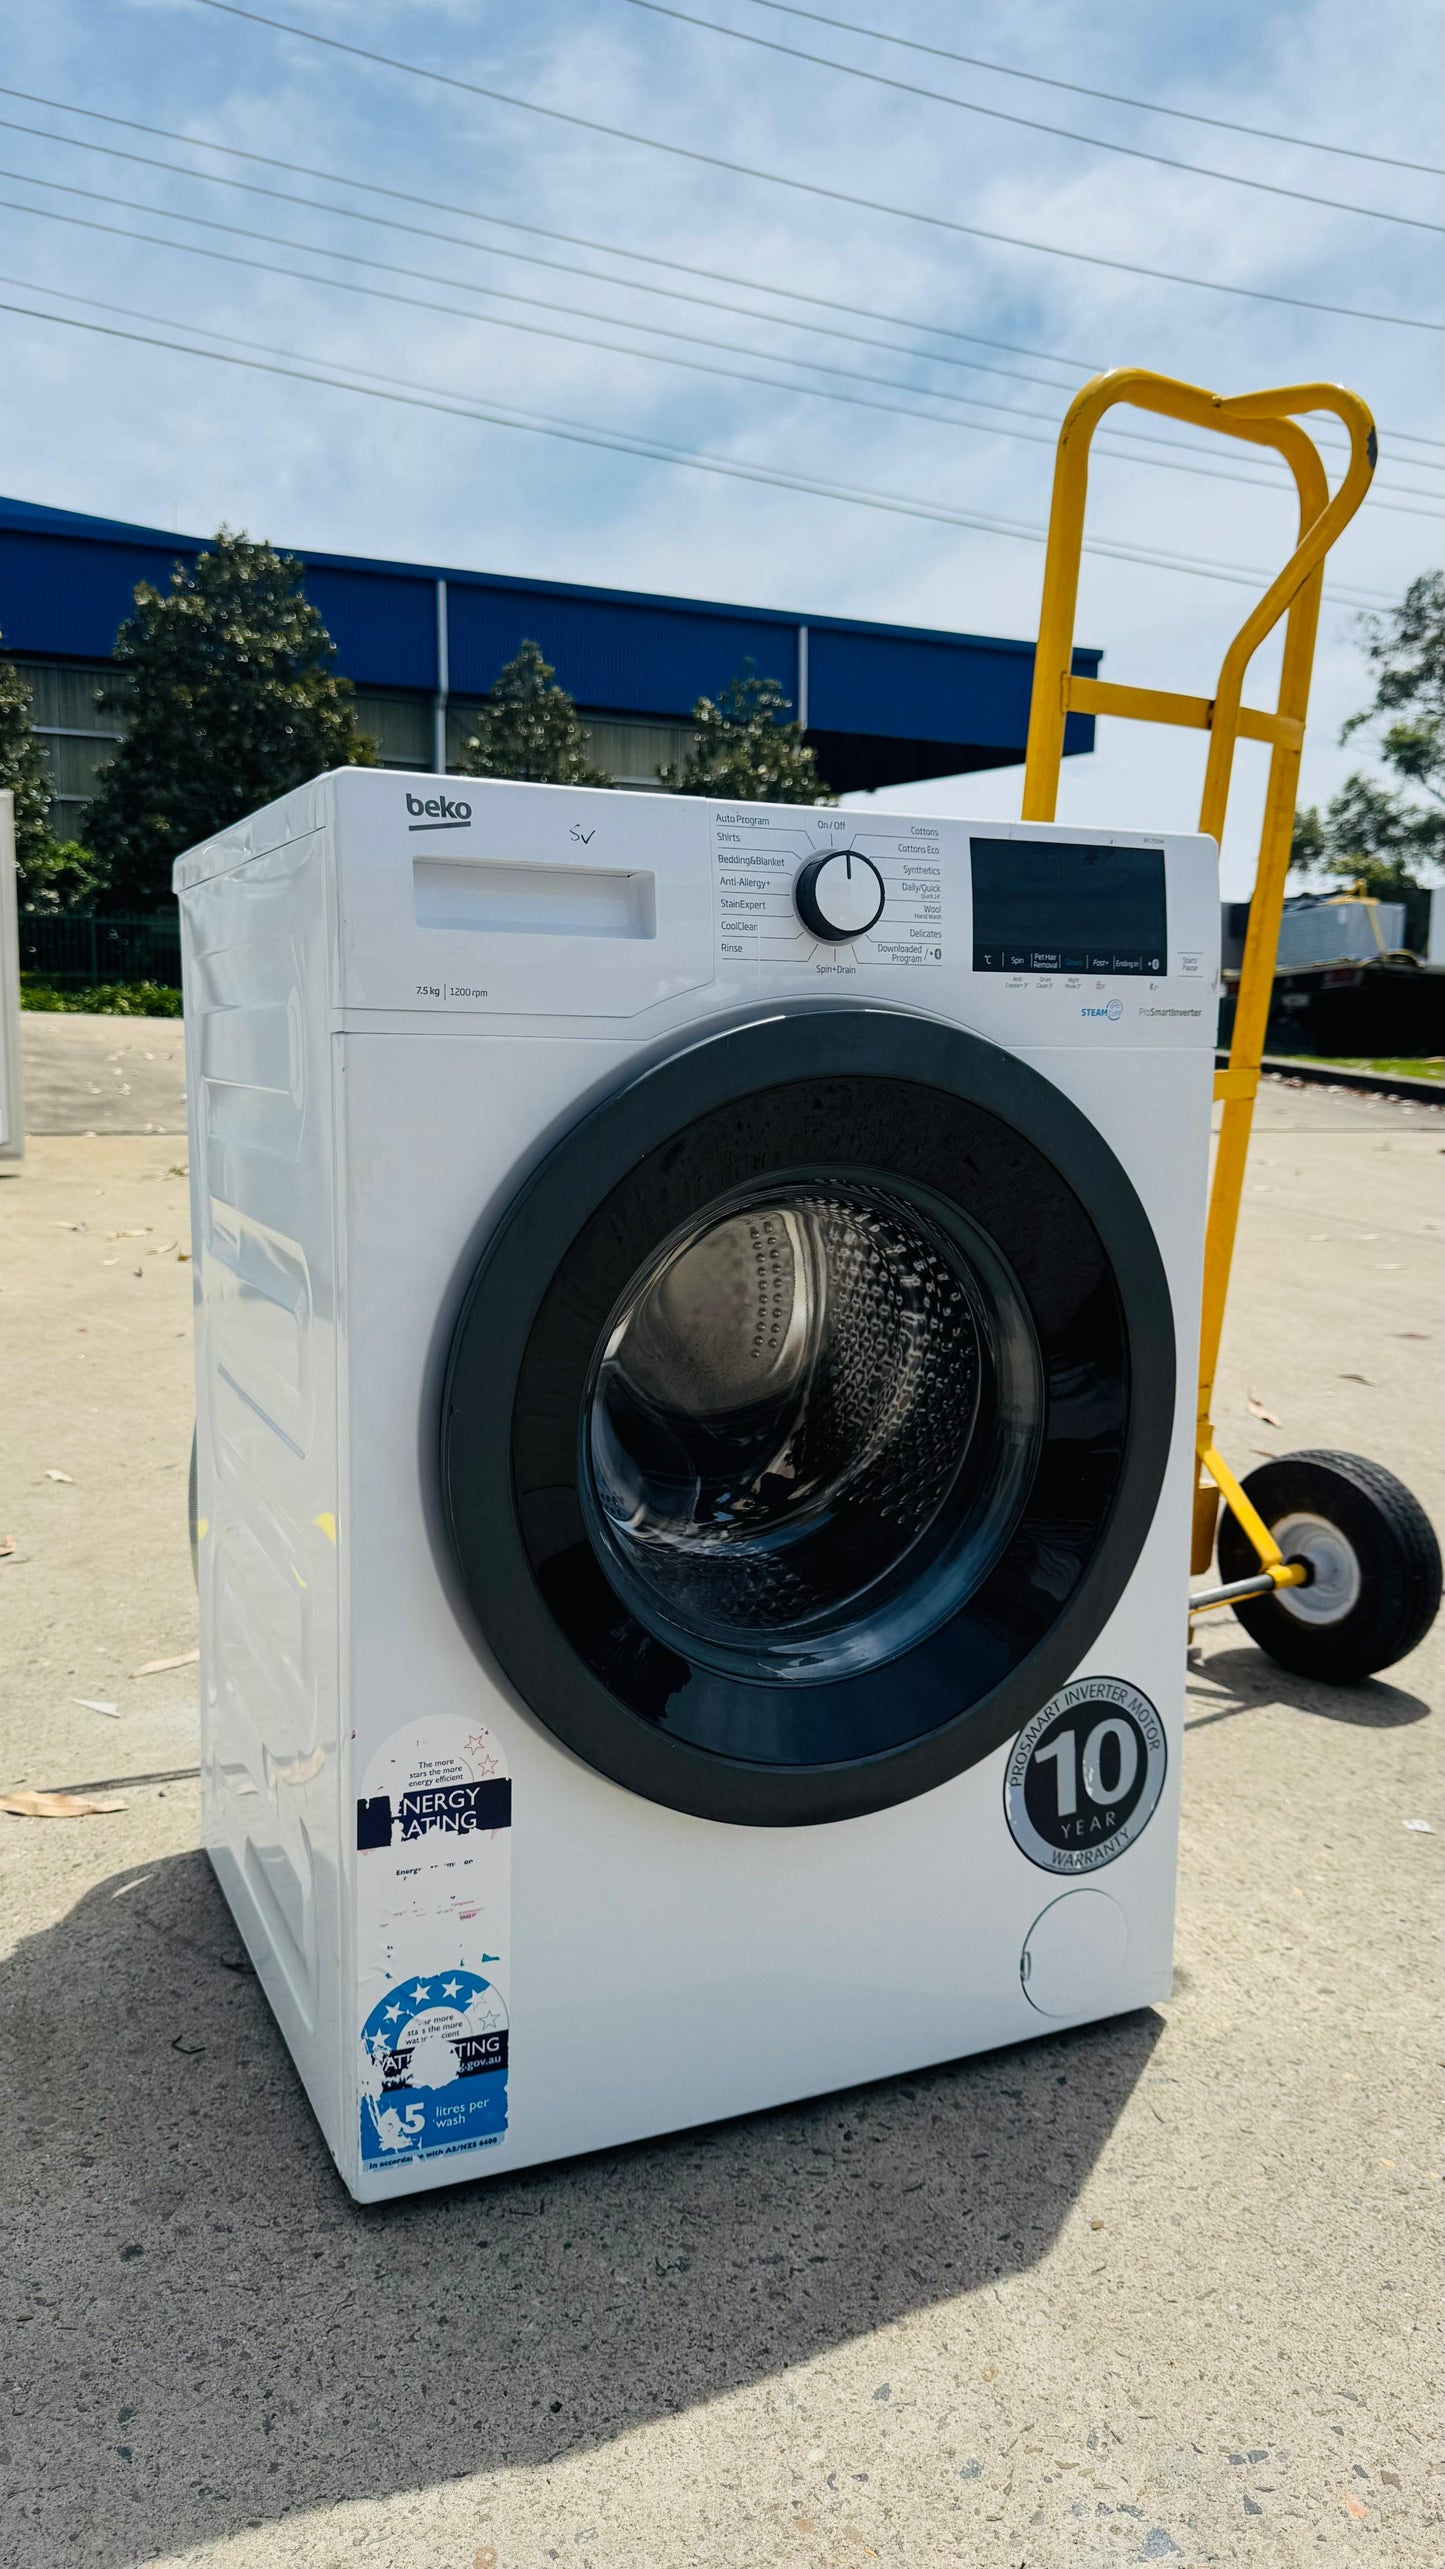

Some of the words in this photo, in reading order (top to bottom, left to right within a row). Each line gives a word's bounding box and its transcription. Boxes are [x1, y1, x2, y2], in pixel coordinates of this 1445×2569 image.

[406, 793, 472, 820] beko
[716, 814, 736, 824] Auto
[736, 815, 770, 826] Program
[717, 832, 740, 842] Shirts
[911, 827, 938, 836] Cottons
[898, 844, 925, 854] Cottons
[926, 846, 940, 854] Eco
[718, 854, 784, 867] Bedding&Blanket
[903, 864, 940, 876] Synthetics
[720, 877, 770, 889] Anti-Allergy+
[902, 882, 941, 894] Daily/Quick
[721, 899, 766, 911] StainExpert
[924, 905, 942, 913] Wool
[721, 921, 758, 931] CoolClean
[910, 929, 942, 938] Delicates
[721, 944, 742, 952] Rinse
[878, 944, 922, 954] Downloaded
[892, 954, 922, 964] Program
[1010, 956, 1024, 965] Spin
[1033, 961, 1058, 969] Removal
[816, 964, 856, 974] Spin+Drain
[450, 988, 471, 997] 1200
[472, 990, 488, 998] rpm
[1010, 1699, 1062, 1787] PROSMART
[1064, 1683, 1128, 1706] INVERTER
[1128, 1698, 1161, 1752] MOTOR
[418, 1761, 432, 1769] The
[1034, 1717, 1138, 1817] 10
[410, 1770, 427, 1779] stars
[442, 1766, 462, 1774] more
[409, 1779, 434, 1787] energy
[435, 1774, 464, 1784] efficient
[1061, 1811, 1116, 1838] YEAR
[1052, 1827, 1129, 1867] WARRANTY
[434, 2014, 454, 2023] more
[408, 2028, 426, 2037] stas
[428, 2024, 440, 2033] the
[442, 2022, 463, 2030] more
[436, 2103, 465, 2118] litres
[470, 2099, 490, 2114] per
[435, 2114, 465, 2128] wash
[426, 2149, 444, 2158] with
[445, 2142, 477, 2154] AS/NZS
[478, 2137, 498, 2146] 6400
